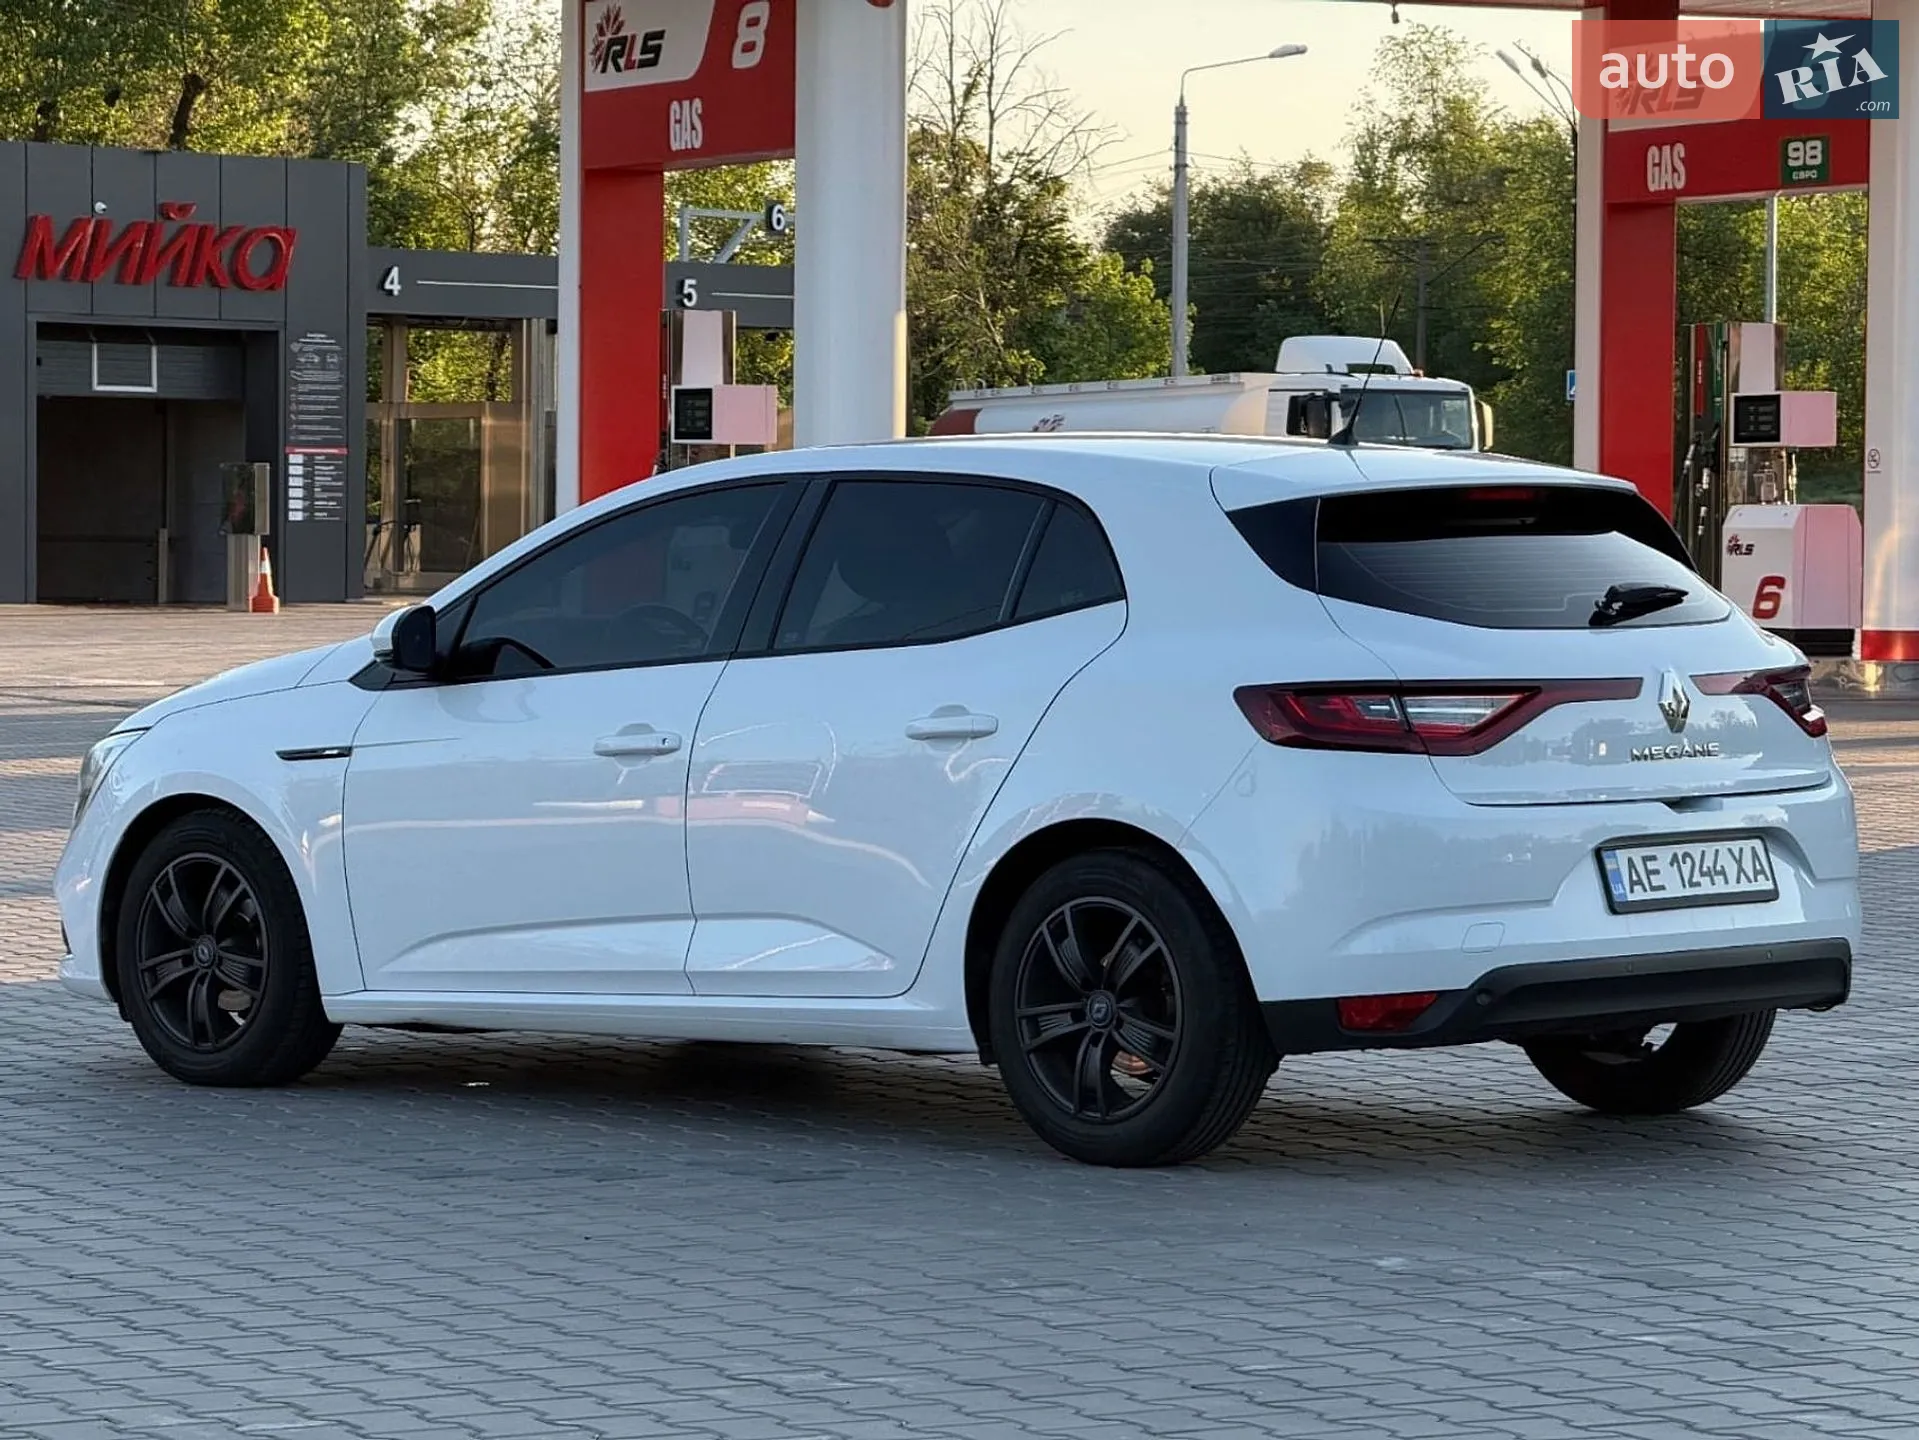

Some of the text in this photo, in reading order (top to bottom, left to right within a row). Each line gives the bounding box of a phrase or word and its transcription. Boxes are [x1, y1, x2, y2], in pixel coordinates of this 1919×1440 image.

[600, 29, 666, 73] RLS
[732, 1, 770, 69] 8
[669, 98, 704, 151] GAS
[1647, 142, 1686, 192] GAS
[1787, 140, 1822, 167] 98
[771, 204, 785, 231] 6
[383, 265, 401, 296] 4
[682, 279, 697, 307] 5
[1752, 575, 1786, 619] 6
[1627, 845, 1770, 894] AE 1244 XA
